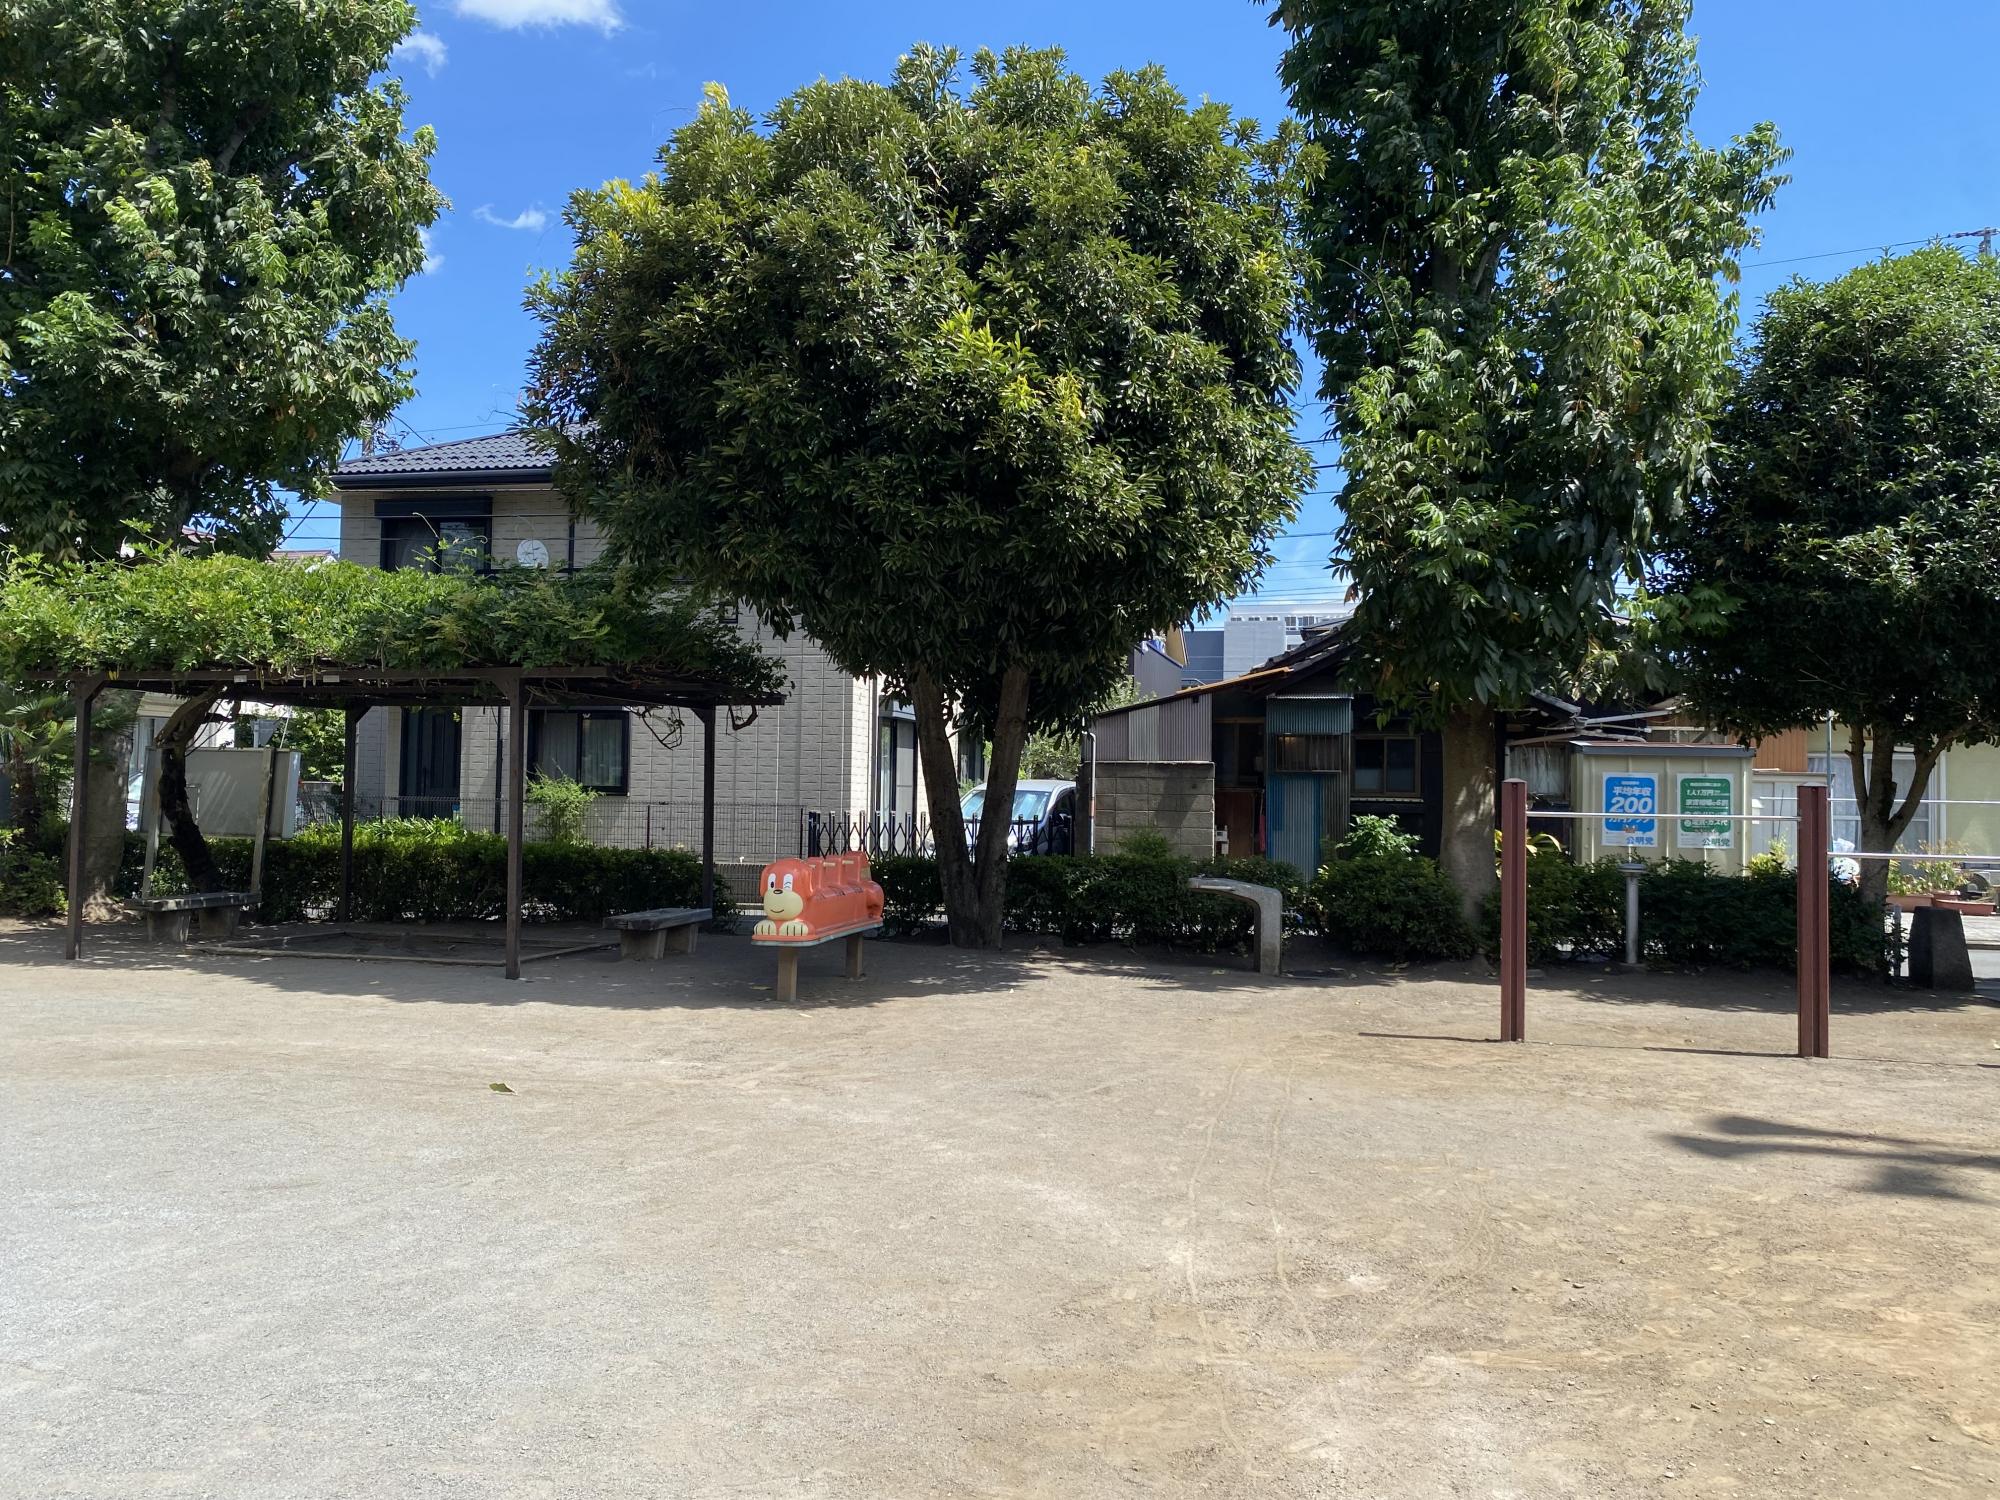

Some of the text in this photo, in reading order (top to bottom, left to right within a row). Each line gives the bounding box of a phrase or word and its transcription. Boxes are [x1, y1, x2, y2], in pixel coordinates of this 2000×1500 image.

[1609, 797, 1653, 814] 200
[1626, 836, 1654, 845] 公明党
[1702, 837, 1730, 846] 公明党
